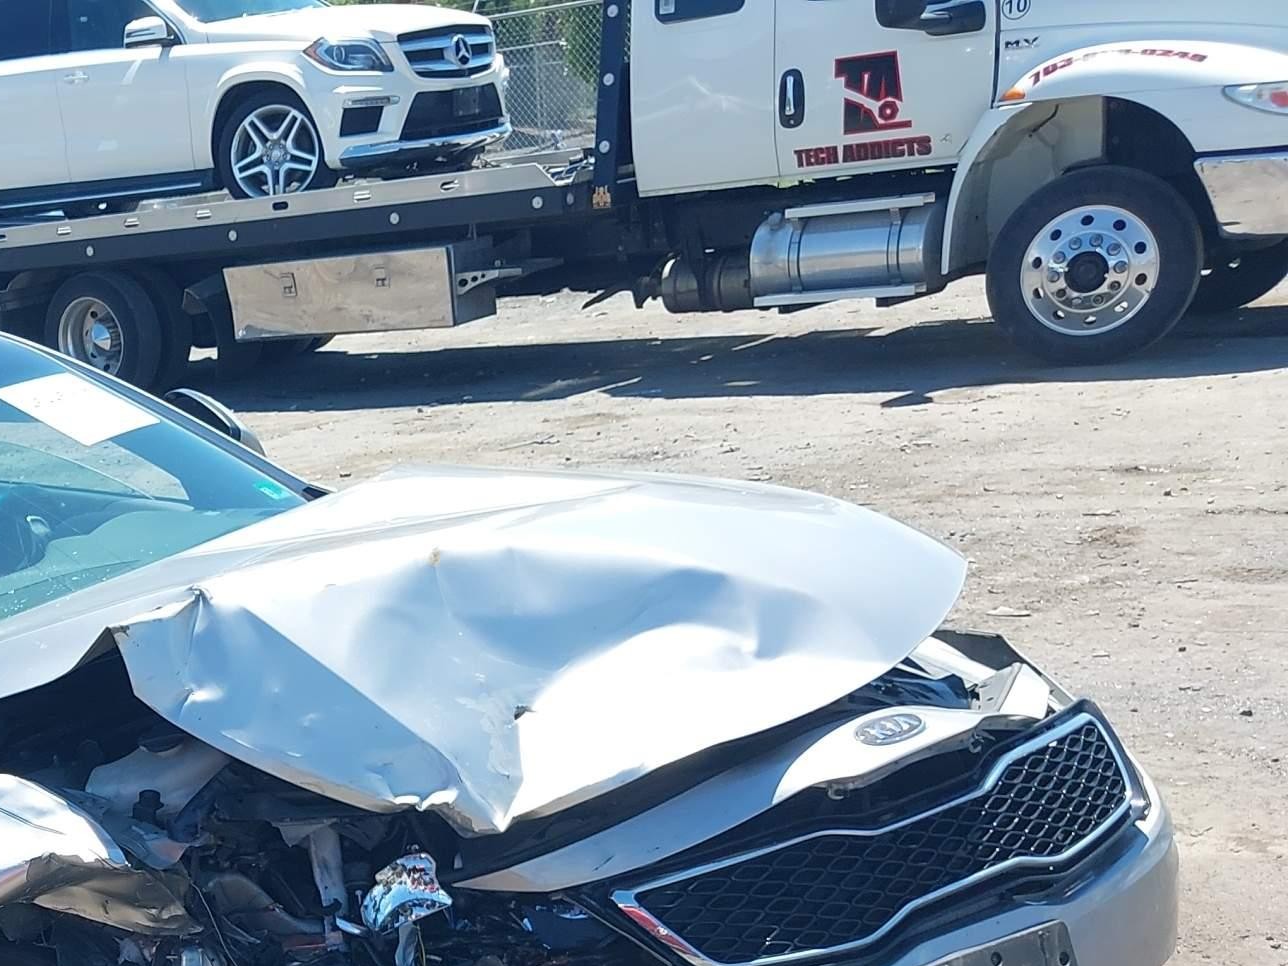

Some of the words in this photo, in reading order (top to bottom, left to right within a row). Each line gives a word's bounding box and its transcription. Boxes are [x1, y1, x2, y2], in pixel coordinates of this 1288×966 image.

[1005, 0, 1028, 14] 10
[793, 145, 840, 168] TECH
[842, 136, 932, 163] ADDICTS
[862, 716, 922, 741] KIA
